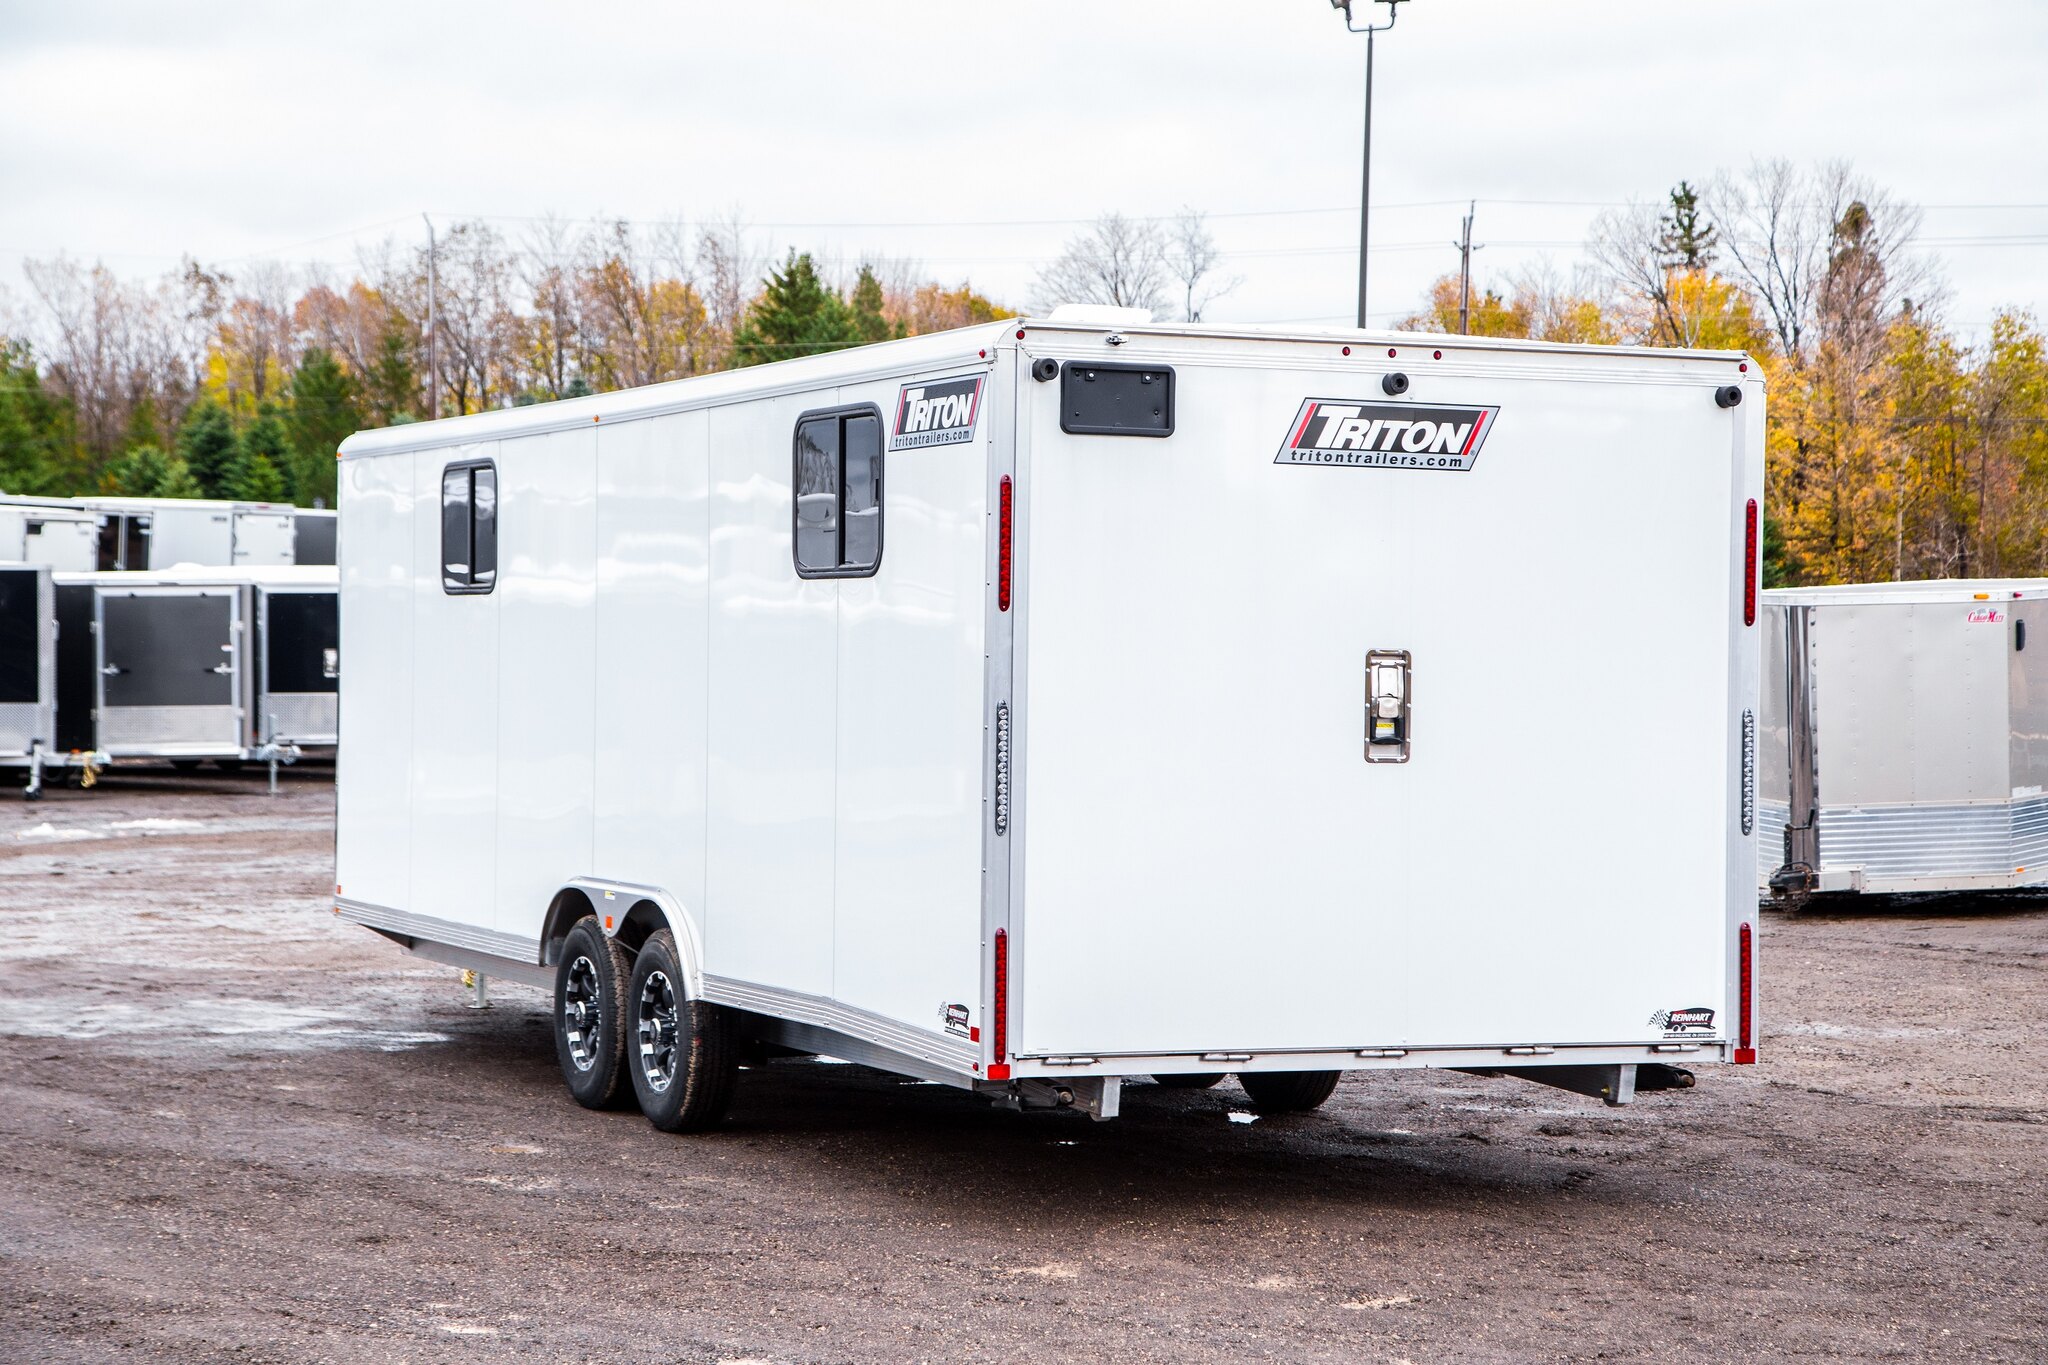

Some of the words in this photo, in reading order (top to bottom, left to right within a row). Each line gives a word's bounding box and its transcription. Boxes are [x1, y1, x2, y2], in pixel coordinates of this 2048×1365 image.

[904, 387, 975, 433] TRITON
[1313, 404, 1473, 454] TRITON
[895, 430, 970, 448] tritontrailers.com
[1290, 449, 1463, 468] tritontrailers.com
[1670, 1013, 1711, 1022] REINHART
